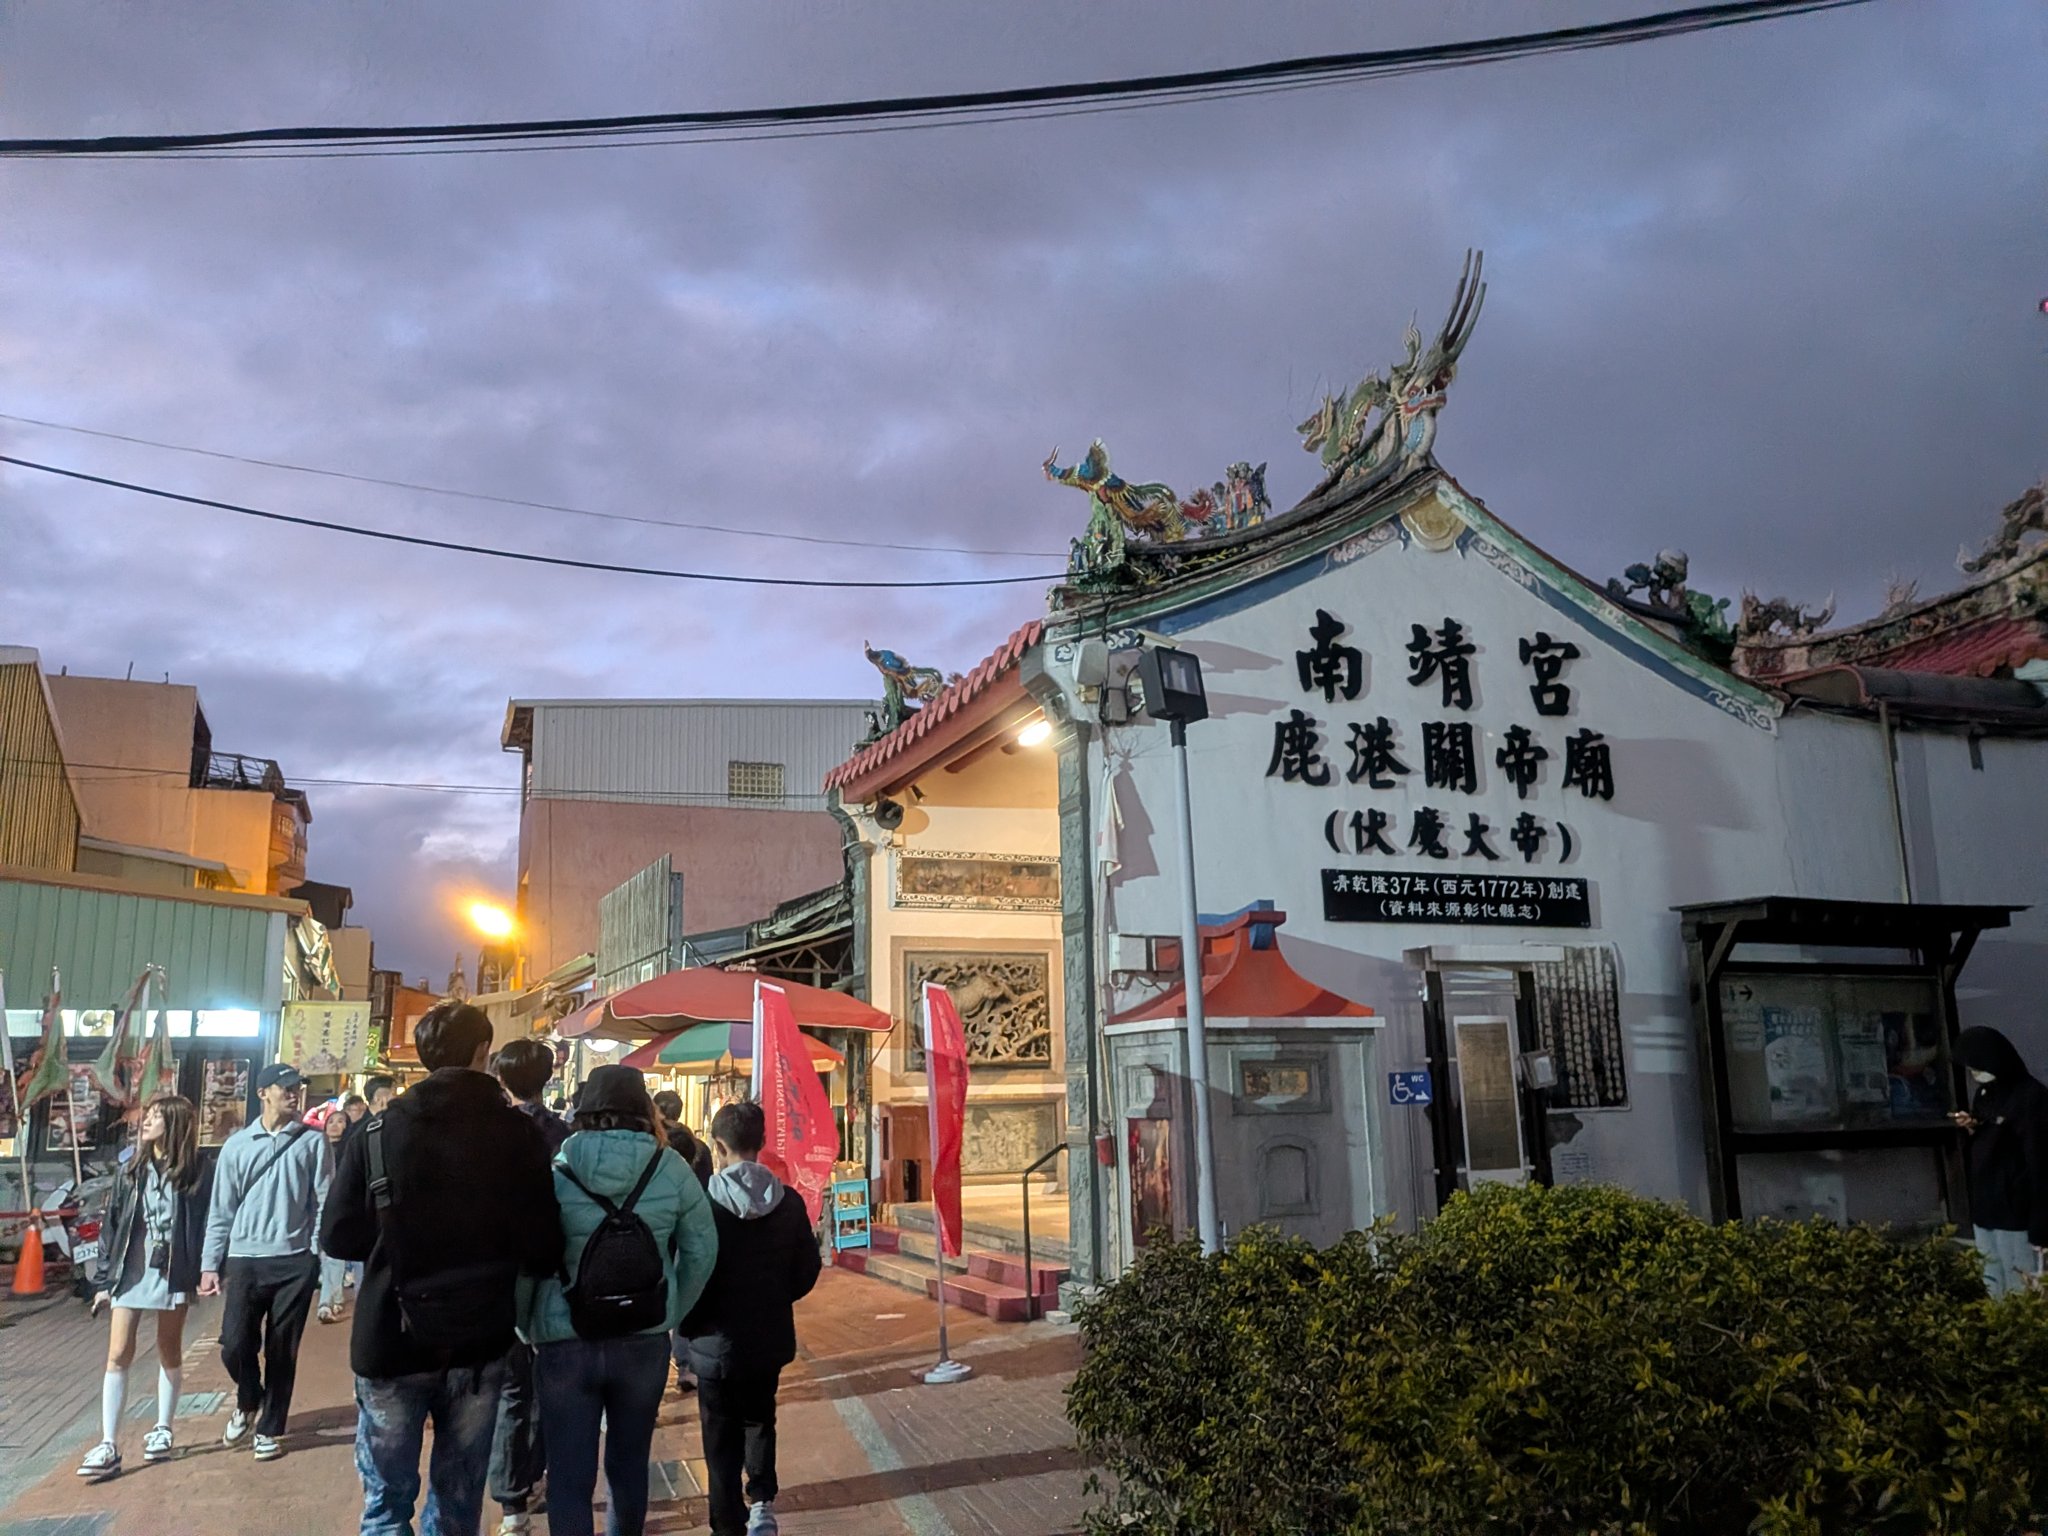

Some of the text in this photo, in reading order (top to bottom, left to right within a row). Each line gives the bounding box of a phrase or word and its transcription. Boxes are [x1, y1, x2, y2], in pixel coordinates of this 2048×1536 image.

[1295, 608, 1581, 716] 南靖宮
[1265, 709, 1615, 801] 鹿港關帝廟
[1324, 806, 1572, 864] (伏魔大帝)
[1411, 1074, 1425, 1083] WC
